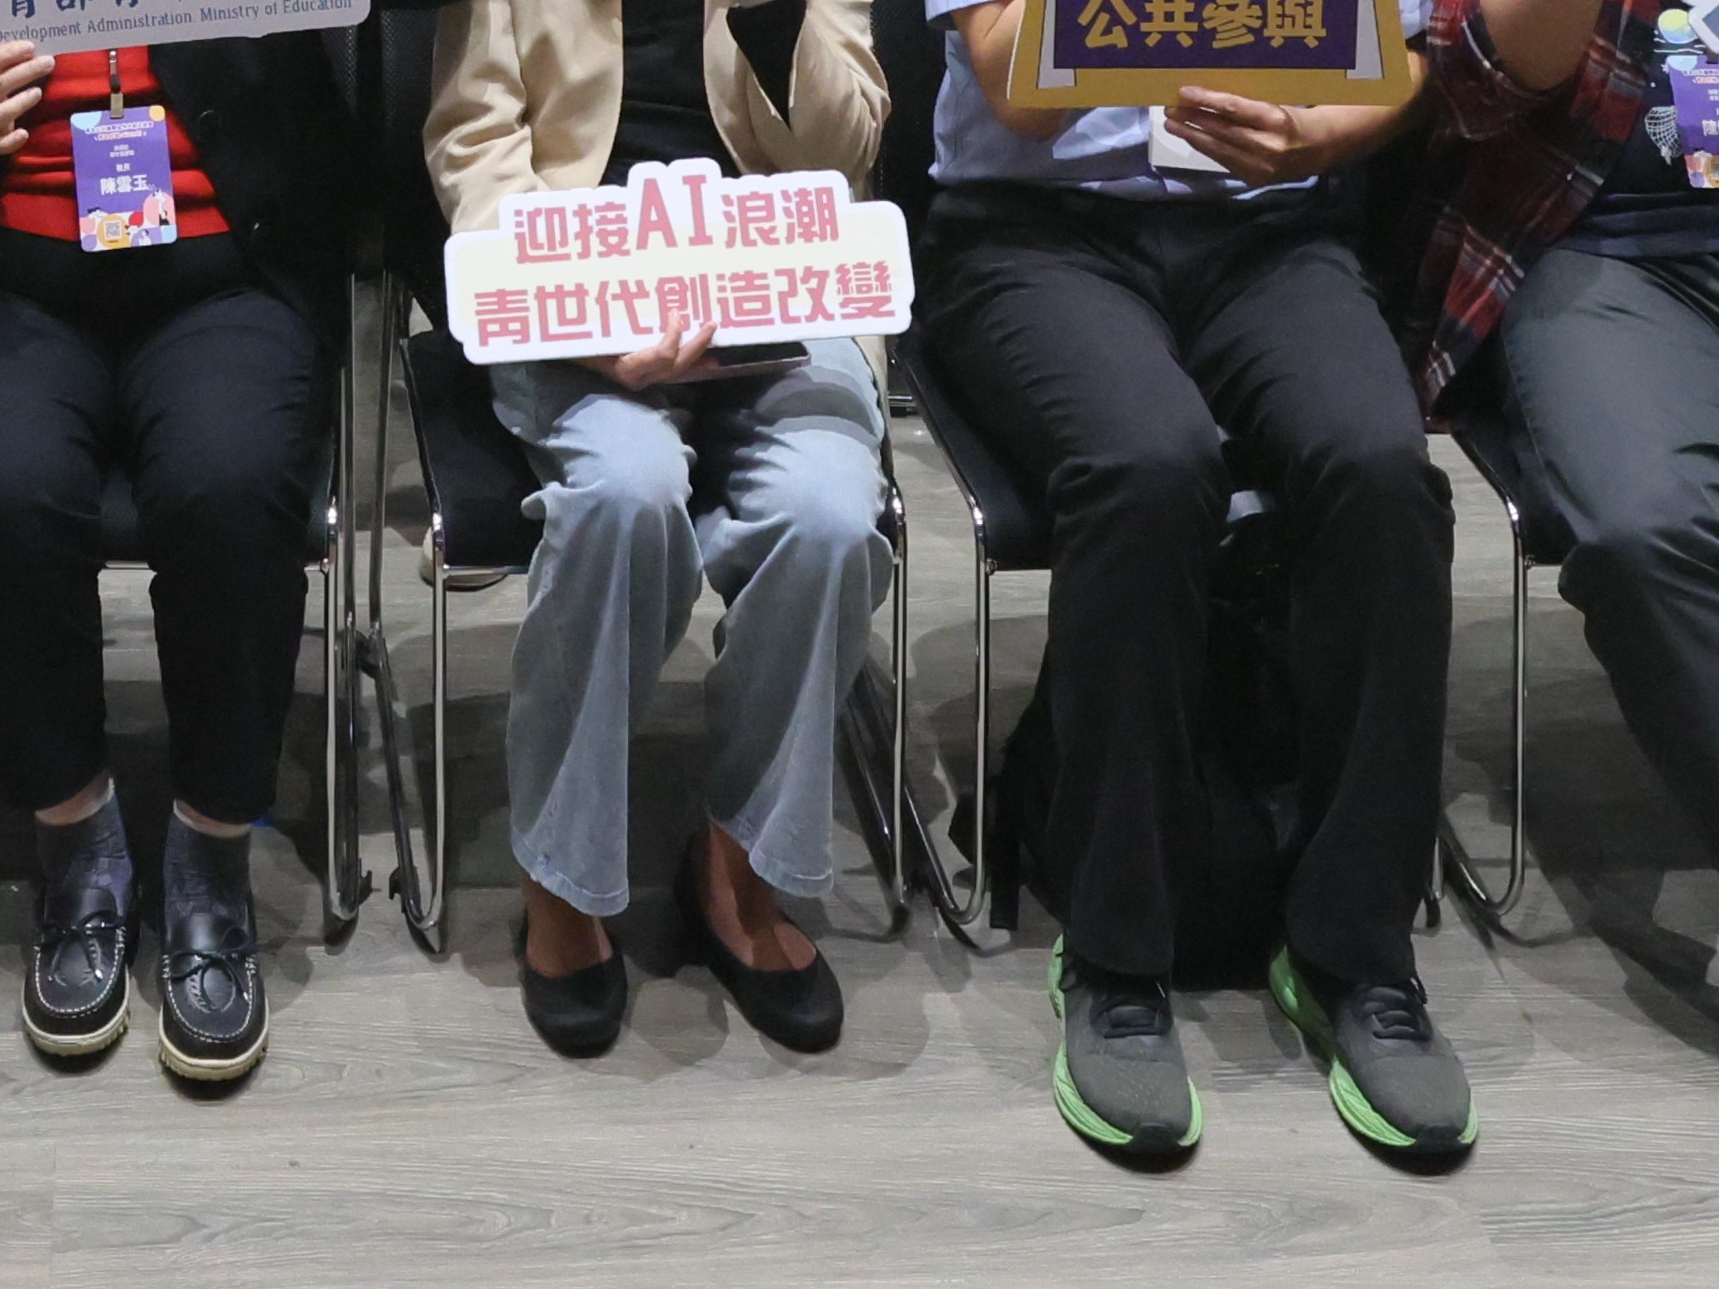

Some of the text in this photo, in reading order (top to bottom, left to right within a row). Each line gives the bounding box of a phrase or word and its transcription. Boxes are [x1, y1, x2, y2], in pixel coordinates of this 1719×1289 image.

[85, 7, 194, 35] Administration
[198, 0, 260, 27] Ministry
[264, 0, 278, 16] of
[513, 176, 840, 267] 迎接AI浪潮
